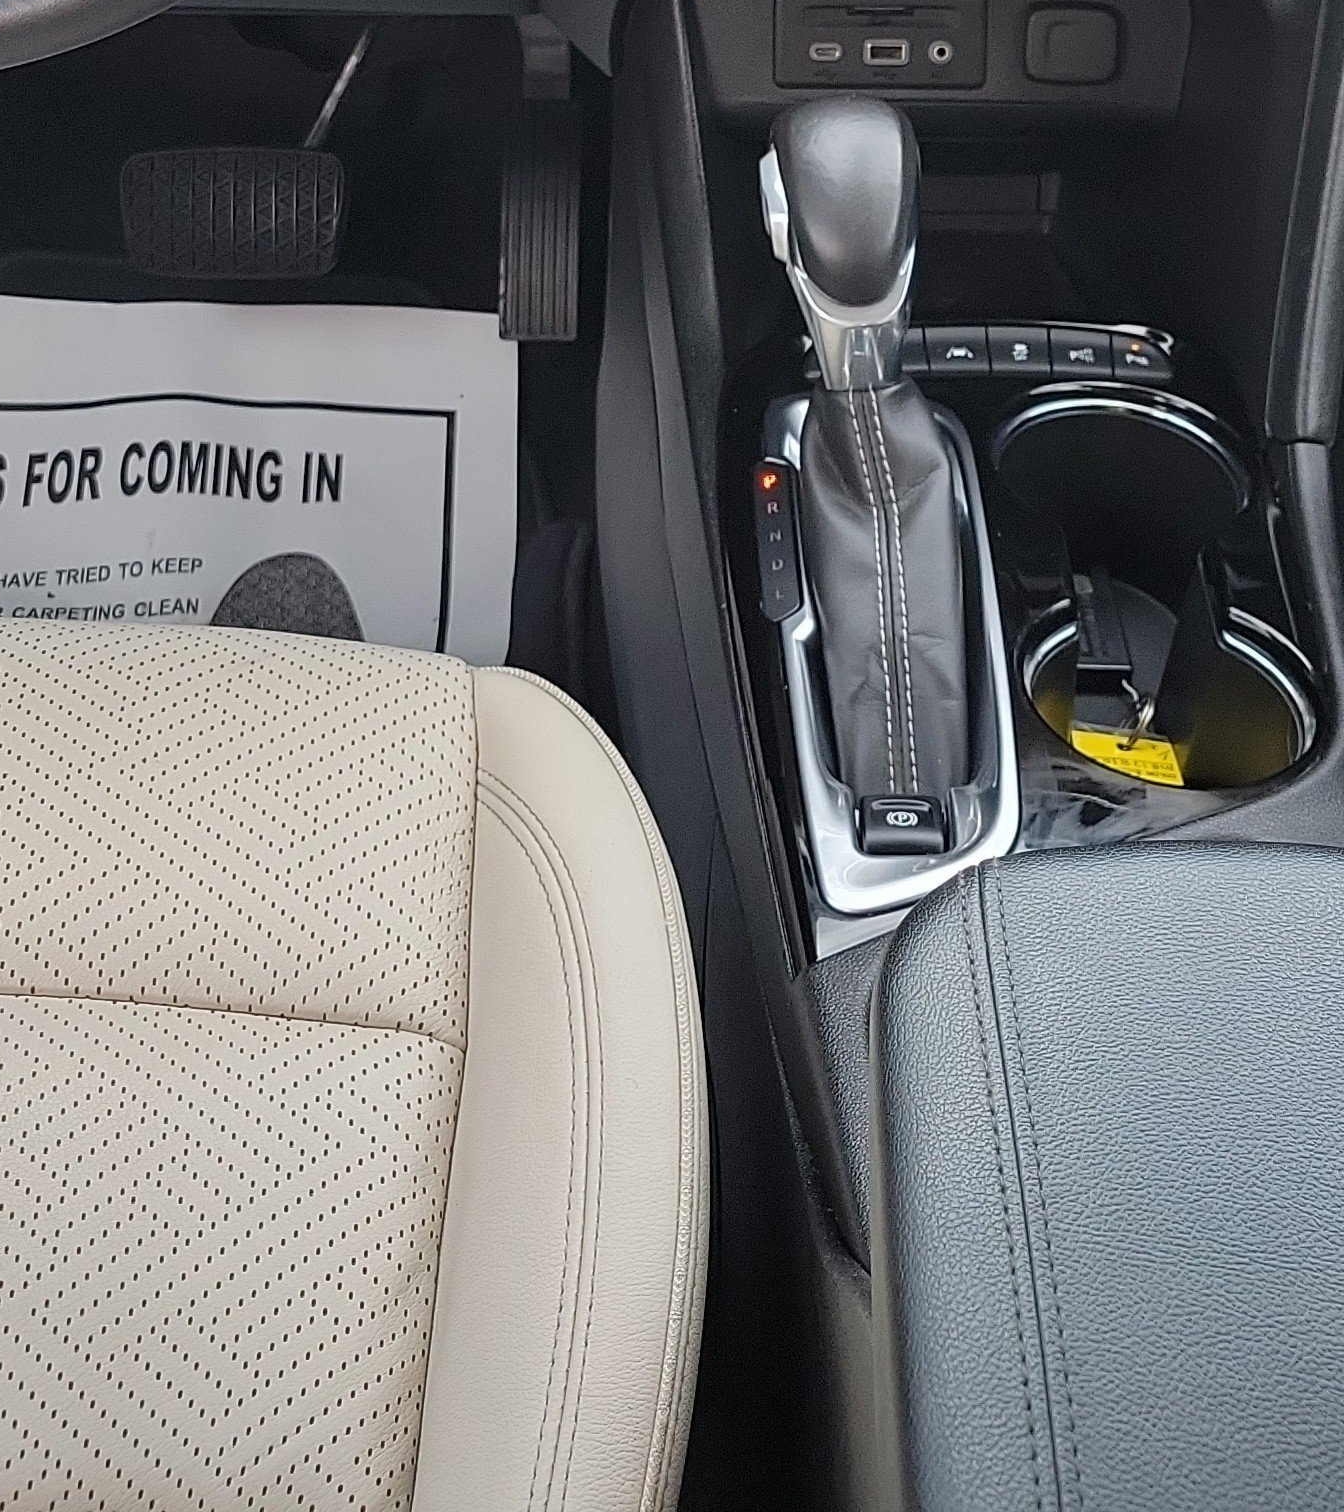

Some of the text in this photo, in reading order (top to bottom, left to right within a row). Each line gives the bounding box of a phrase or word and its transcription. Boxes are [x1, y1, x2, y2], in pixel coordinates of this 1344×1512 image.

[22, 447, 102, 507] FOR
[120, 440, 283, 503] COMING
[302, 452, 344, 503] IN
[763, 474, 776, 489] P
[767, 501, 779, 514] R
[770, 529, 781, 542] N
[56, 564, 111, 585] TRIED
[119, 560, 143, 580] TO
[151, 557, 203, 576] KEEP
[12, 603, 125, 621] CARPETING
[134, 597, 200, 617] CLEAN
